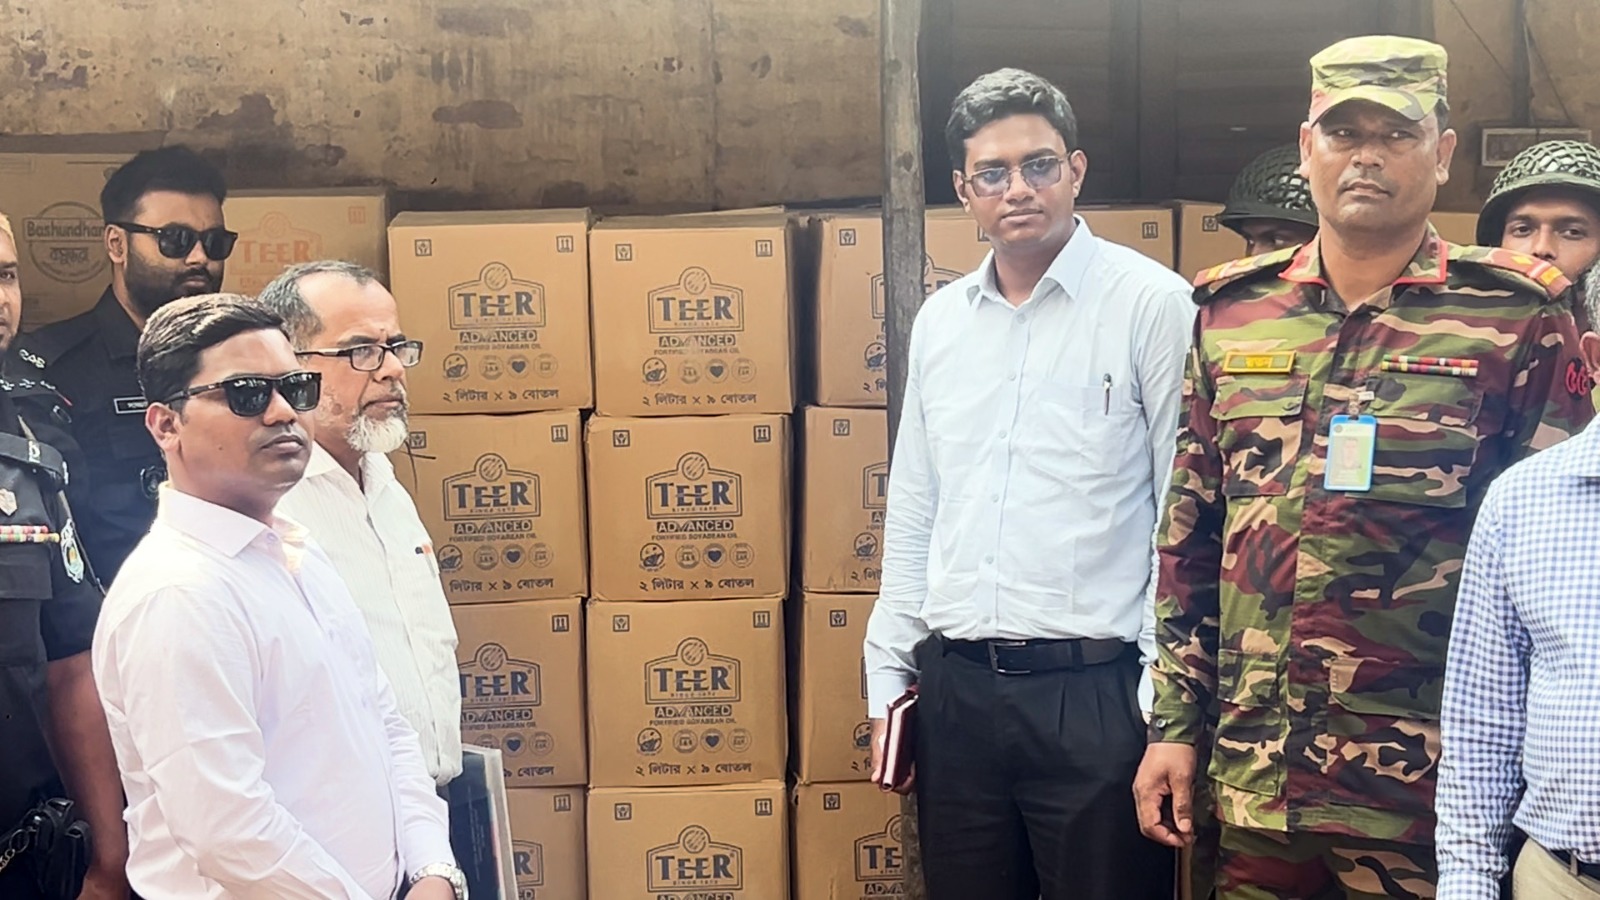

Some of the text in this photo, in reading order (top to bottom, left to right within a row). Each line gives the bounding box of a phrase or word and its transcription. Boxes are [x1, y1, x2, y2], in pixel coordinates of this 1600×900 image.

[27, 220, 105, 237] Bashundhar
[240, 240, 311, 263] TEER
[457, 291, 536, 318] TEER
[656, 295, 734, 322] TEER
[443, 391, 453, 402] ২
[456, 388, 489, 402] লিটার
[522, 388, 560, 401] বোতল
[642, 396, 651, 406] ২
[655, 392, 688, 405] লিটার
[721, 392, 757, 404] বোতল
[452, 481, 532, 509] TEER
[655, 480, 733, 508] TEER
[454, 519, 533, 535] ADVANCED
[657, 519, 734, 534] ADVANCED
[450, 579, 483, 593] লিটার
[517, 577, 555, 590] বোতল
[639, 580, 649, 592] ২
[652, 577, 685, 591] লিটার
[718, 577, 755, 589] বোতল
[460, 670, 531, 698] TEER
[653, 666, 731, 693] TEER
[655, 703, 733, 718] ADVANCED
[518, 765, 555, 778] বোতল
[635, 765, 645, 776] ২
[648, 762, 682, 776] লিটার
[715, 762, 752, 774] বোতল
[863, 845, 902, 869] TE
[655, 853, 734, 880] TEER
